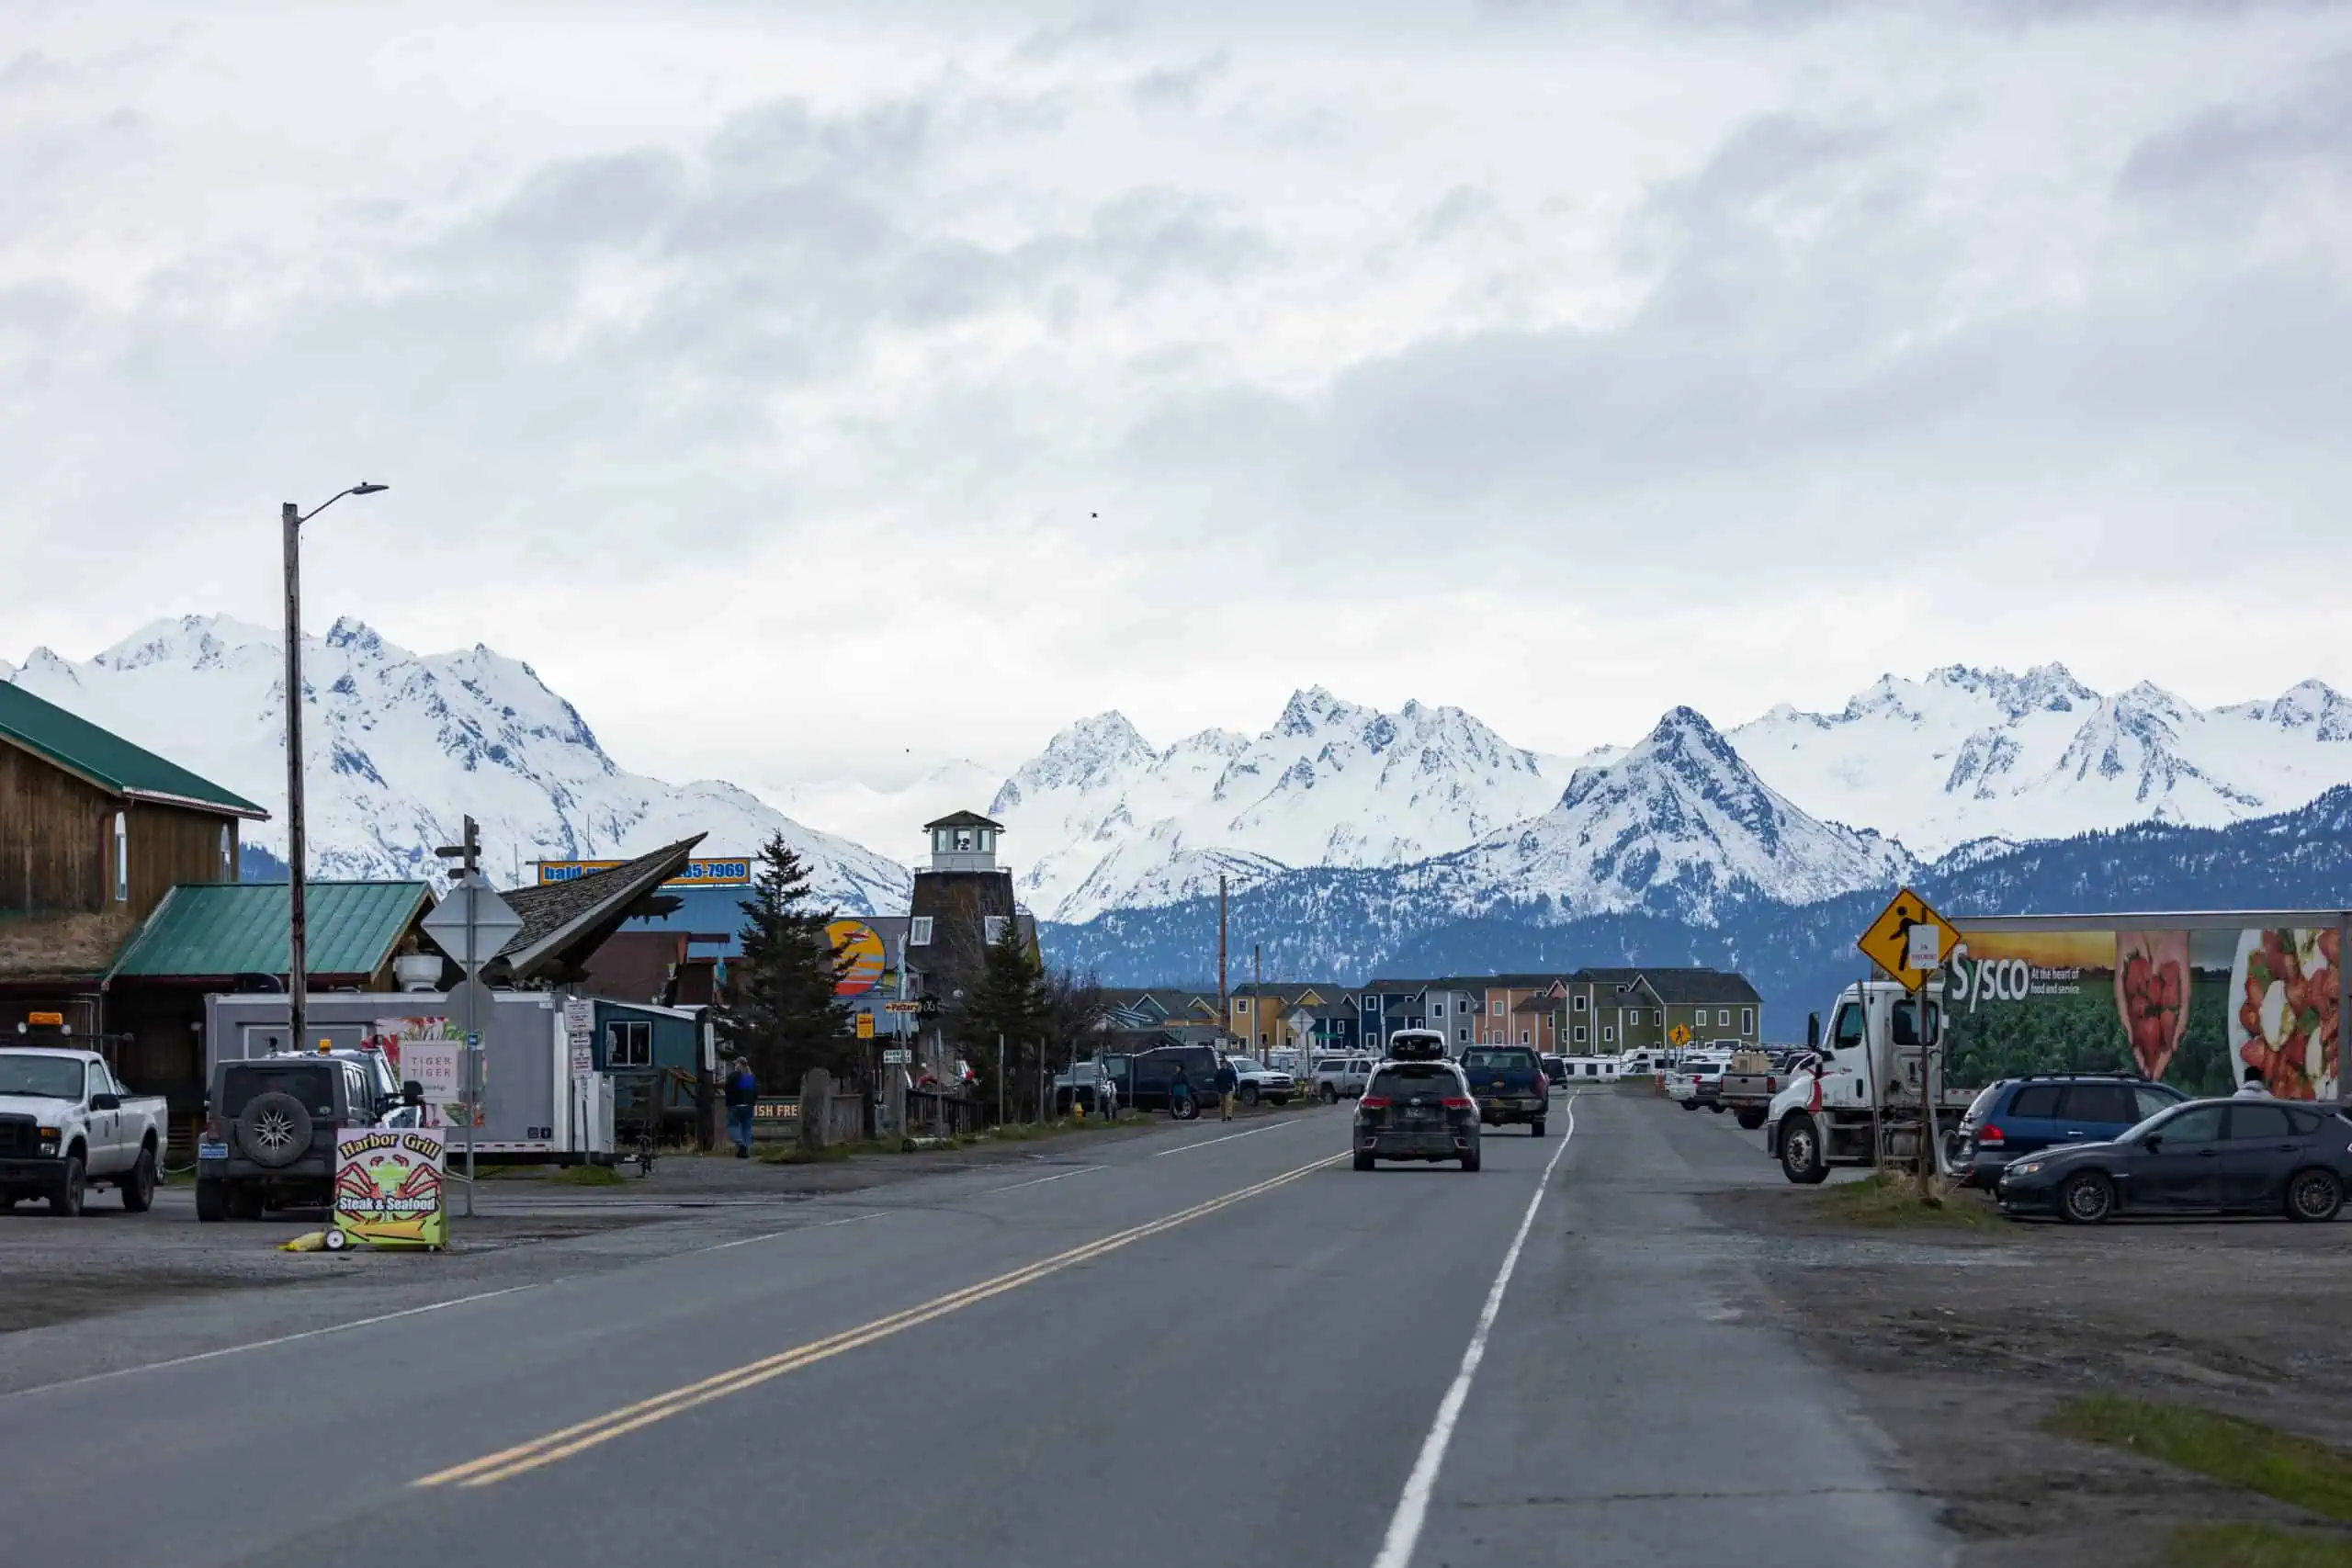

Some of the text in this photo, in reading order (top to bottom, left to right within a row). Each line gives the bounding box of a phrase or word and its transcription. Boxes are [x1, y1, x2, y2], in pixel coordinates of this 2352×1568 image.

[544, 865, 582, 880] bald
[2031, 967, 2080, 980] At the heart of
[2030, 982, 2045, 994] food
[2046, 983, 2057, 994] and
[411, 1056, 452, 1066] TIGER
[411, 1068, 451, 1077] TIGER
[753, 1105, 798, 1117] ISH FRE
[339, 1133, 441, 1160] Harbor Grill
[339, 1197, 435, 1211] Steak & Seafood
